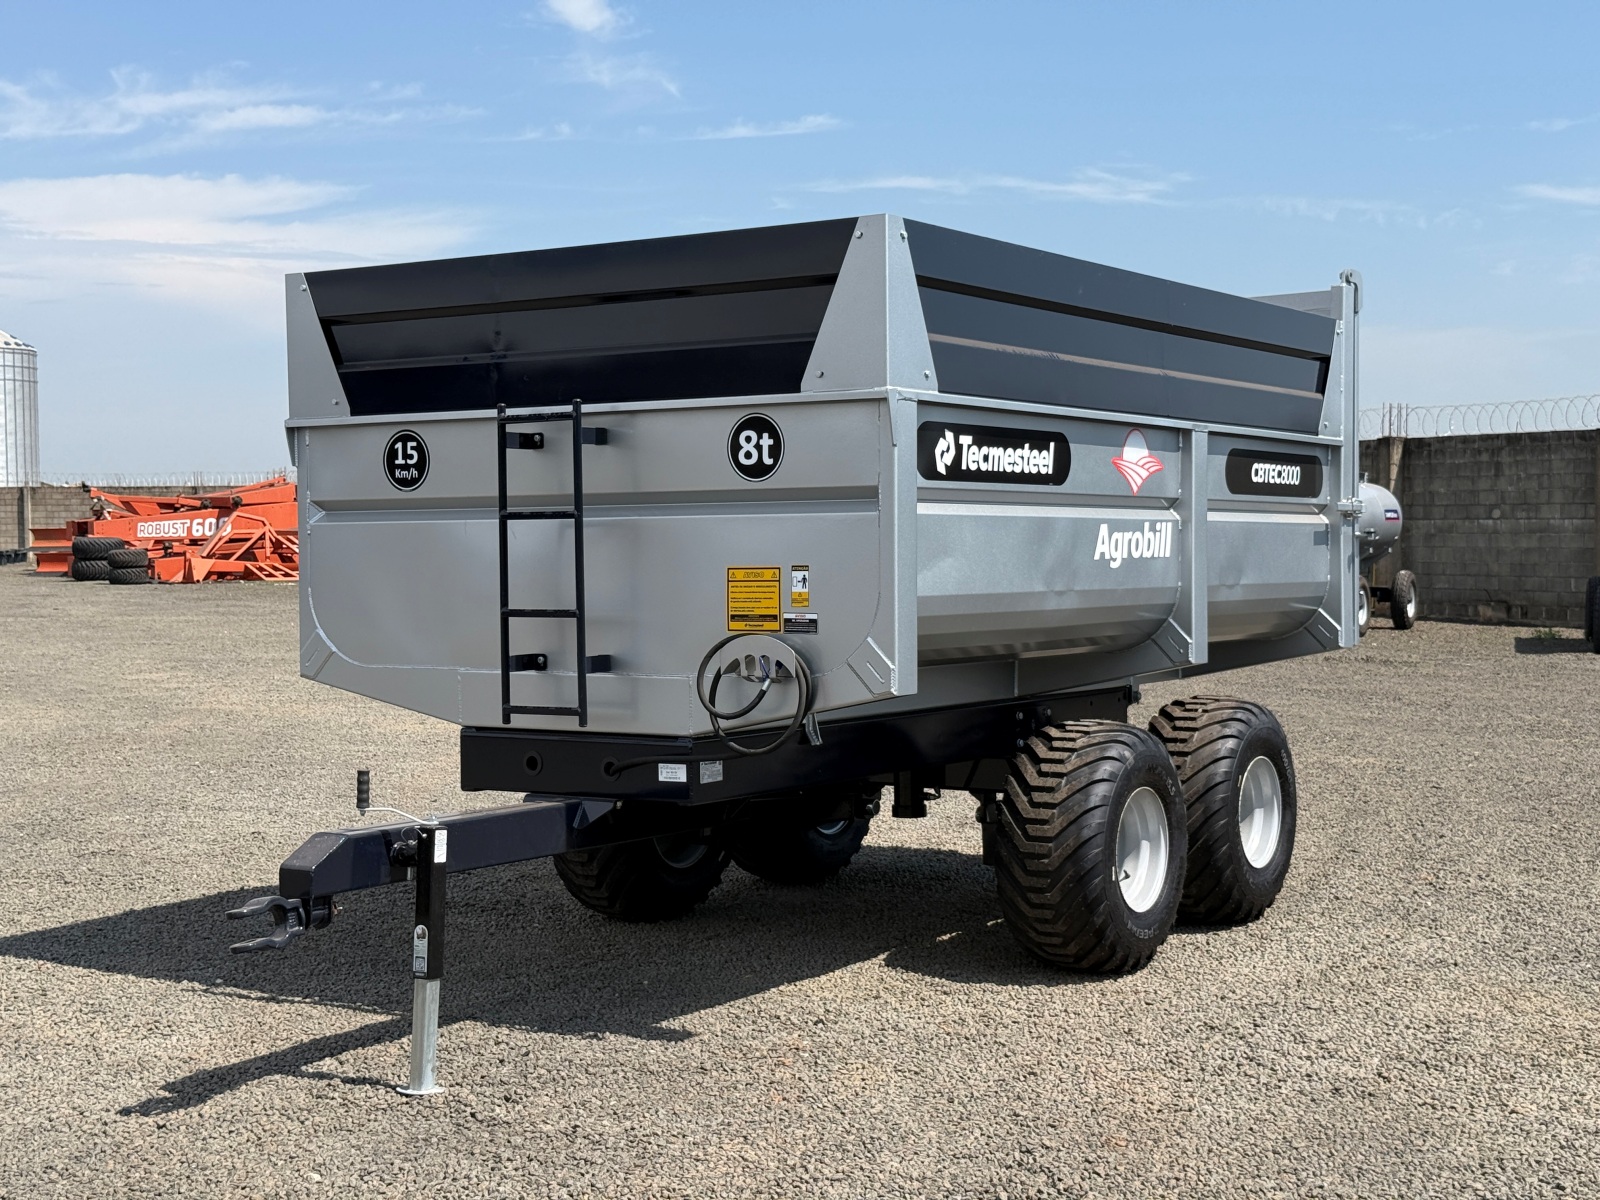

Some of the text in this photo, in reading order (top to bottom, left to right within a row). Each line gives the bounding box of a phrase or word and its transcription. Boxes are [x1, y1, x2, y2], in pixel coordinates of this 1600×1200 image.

[394, 441, 419, 465] 15
[738, 429, 774, 466] 8t
[958, 434, 1055, 475] Tecmesteel
[395, 467, 419, 480] Km/h
[1251, 462, 1301, 486] CBTEC8000
[137, 520, 190, 537] ROBUST
[1093, 521, 1173, 569] Agrobill
[743, 571, 765, 579] AVISO
